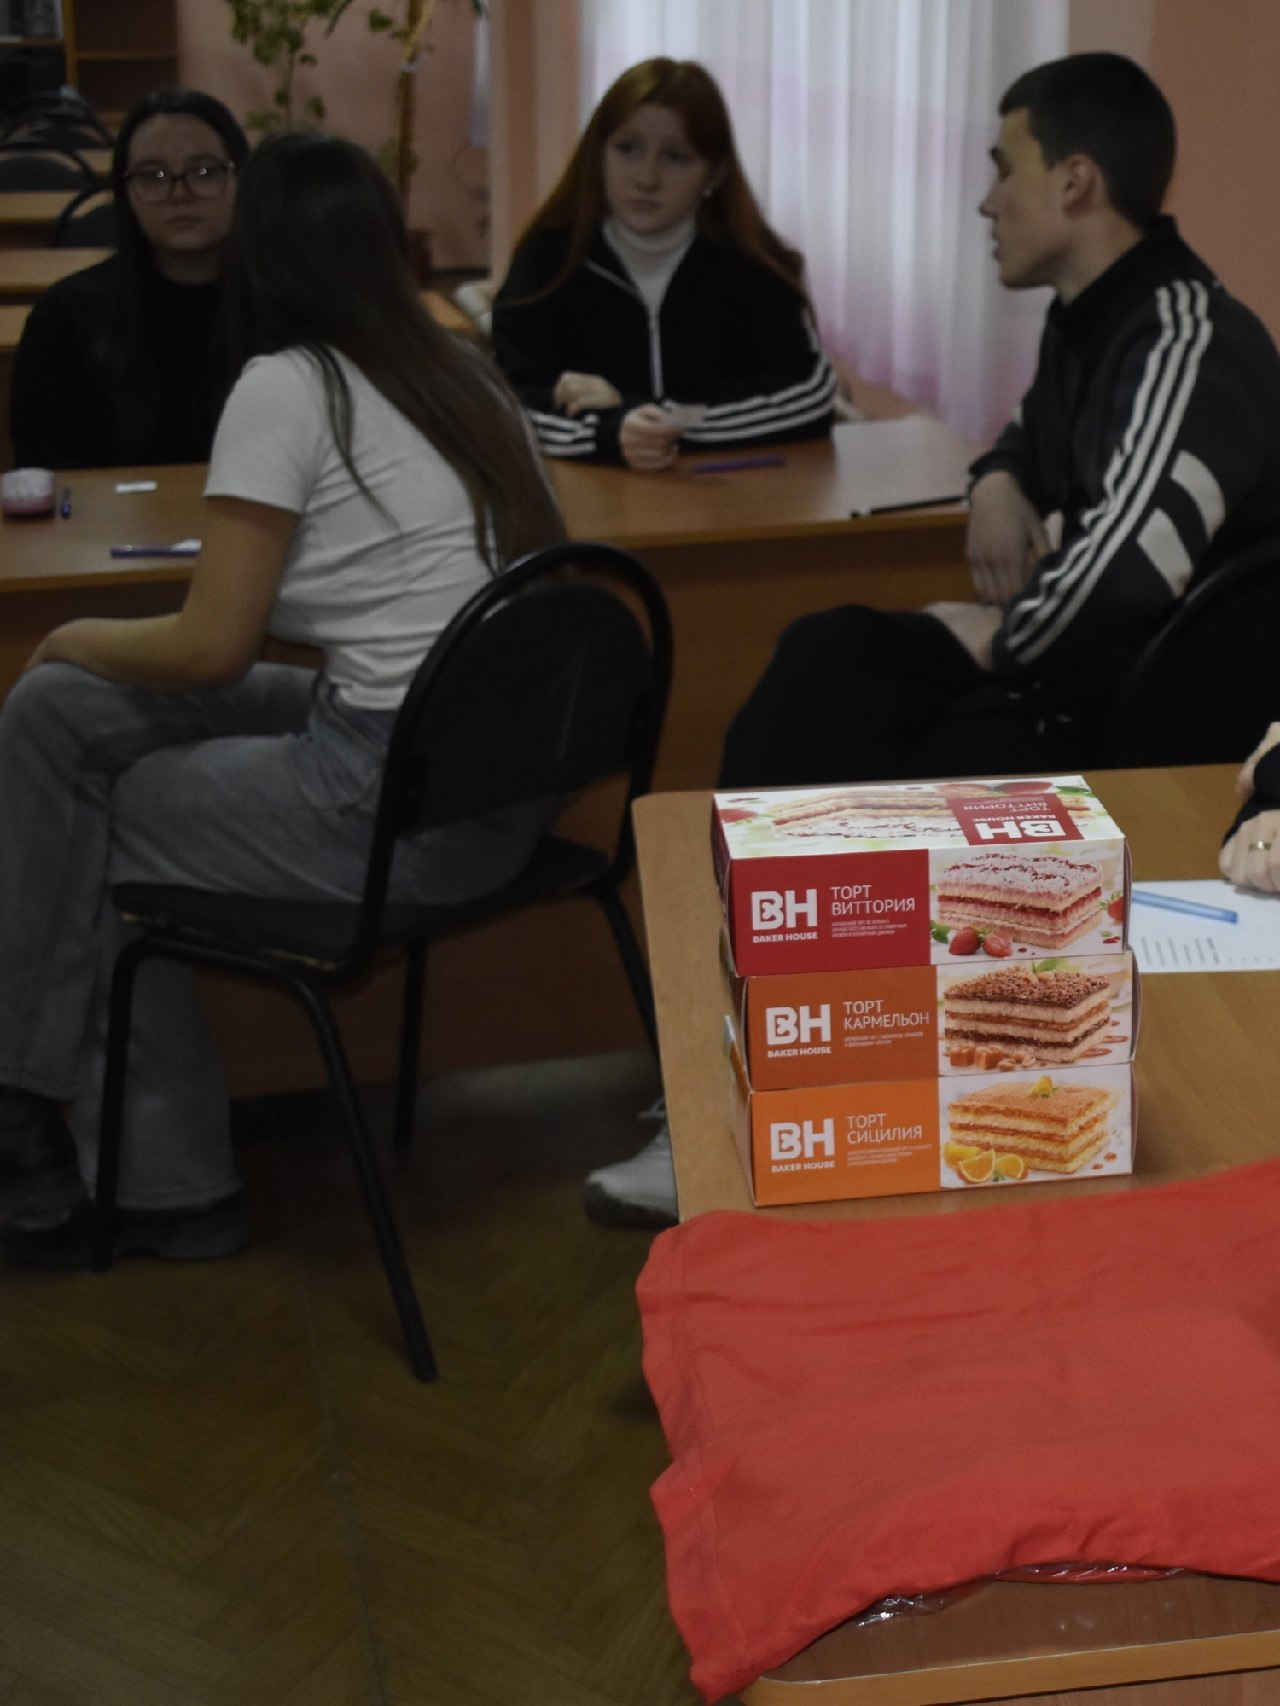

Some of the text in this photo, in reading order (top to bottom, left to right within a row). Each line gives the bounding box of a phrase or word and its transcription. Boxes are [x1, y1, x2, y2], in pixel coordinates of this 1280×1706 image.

[974, 820, 1066, 840] BH
[830, 884, 872, 900] ТОРТ
[751, 888, 818, 931] BH
[831, 897, 915, 916] ВИТТОРИЯ
[752, 931, 818, 944] BAKER HOUSE
[843, 999, 885, 1015] ТОРТ
[765, 1003, 832, 1046] BH
[844, 1011, 930, 1031] КАРМЕЛЬОН
[767, 1046, 832, 1059] BAKER HOUSE
[846, 1112, 887, 1129] ТОРТ
[770, 1117, 836, 1161] BH
[847, 1125, 923, 1144] СИЦИЛИЯ
[771, 1160, 836, 1173] BAKER HOUSE
